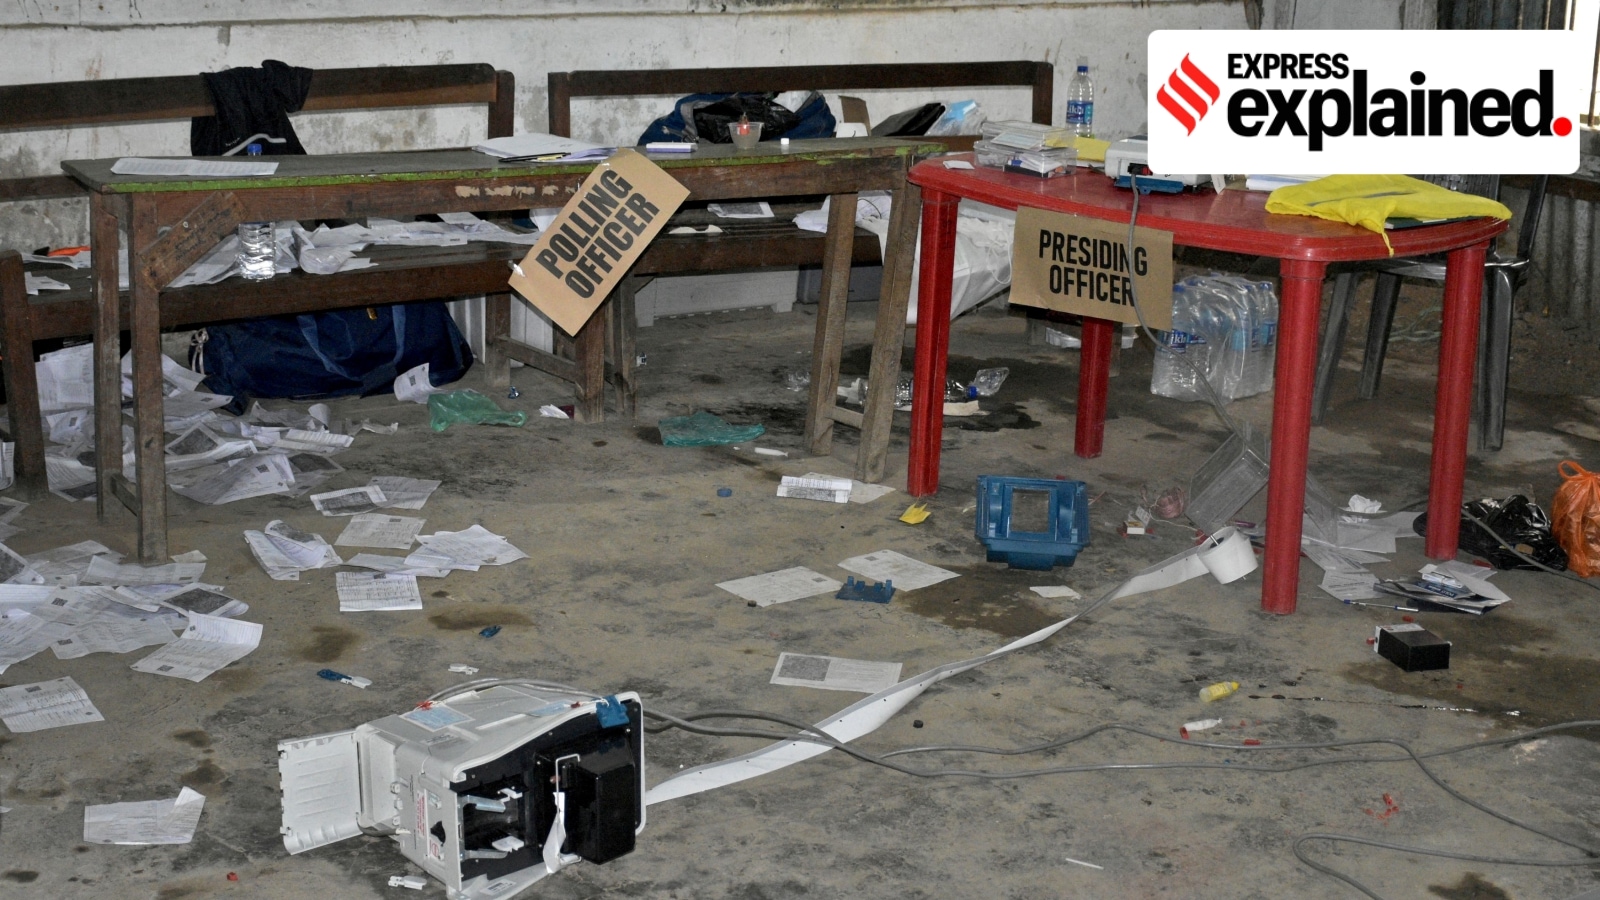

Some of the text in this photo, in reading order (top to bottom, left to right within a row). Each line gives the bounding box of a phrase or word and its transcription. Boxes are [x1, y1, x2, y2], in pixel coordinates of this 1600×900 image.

[535, 169, 633, 279] POLLING
[565, 193, 660, 298] OFFICER
[1039, 229, 1148, 276] PRESIDING
[1050, 265, 1135, 307] OFFICER
